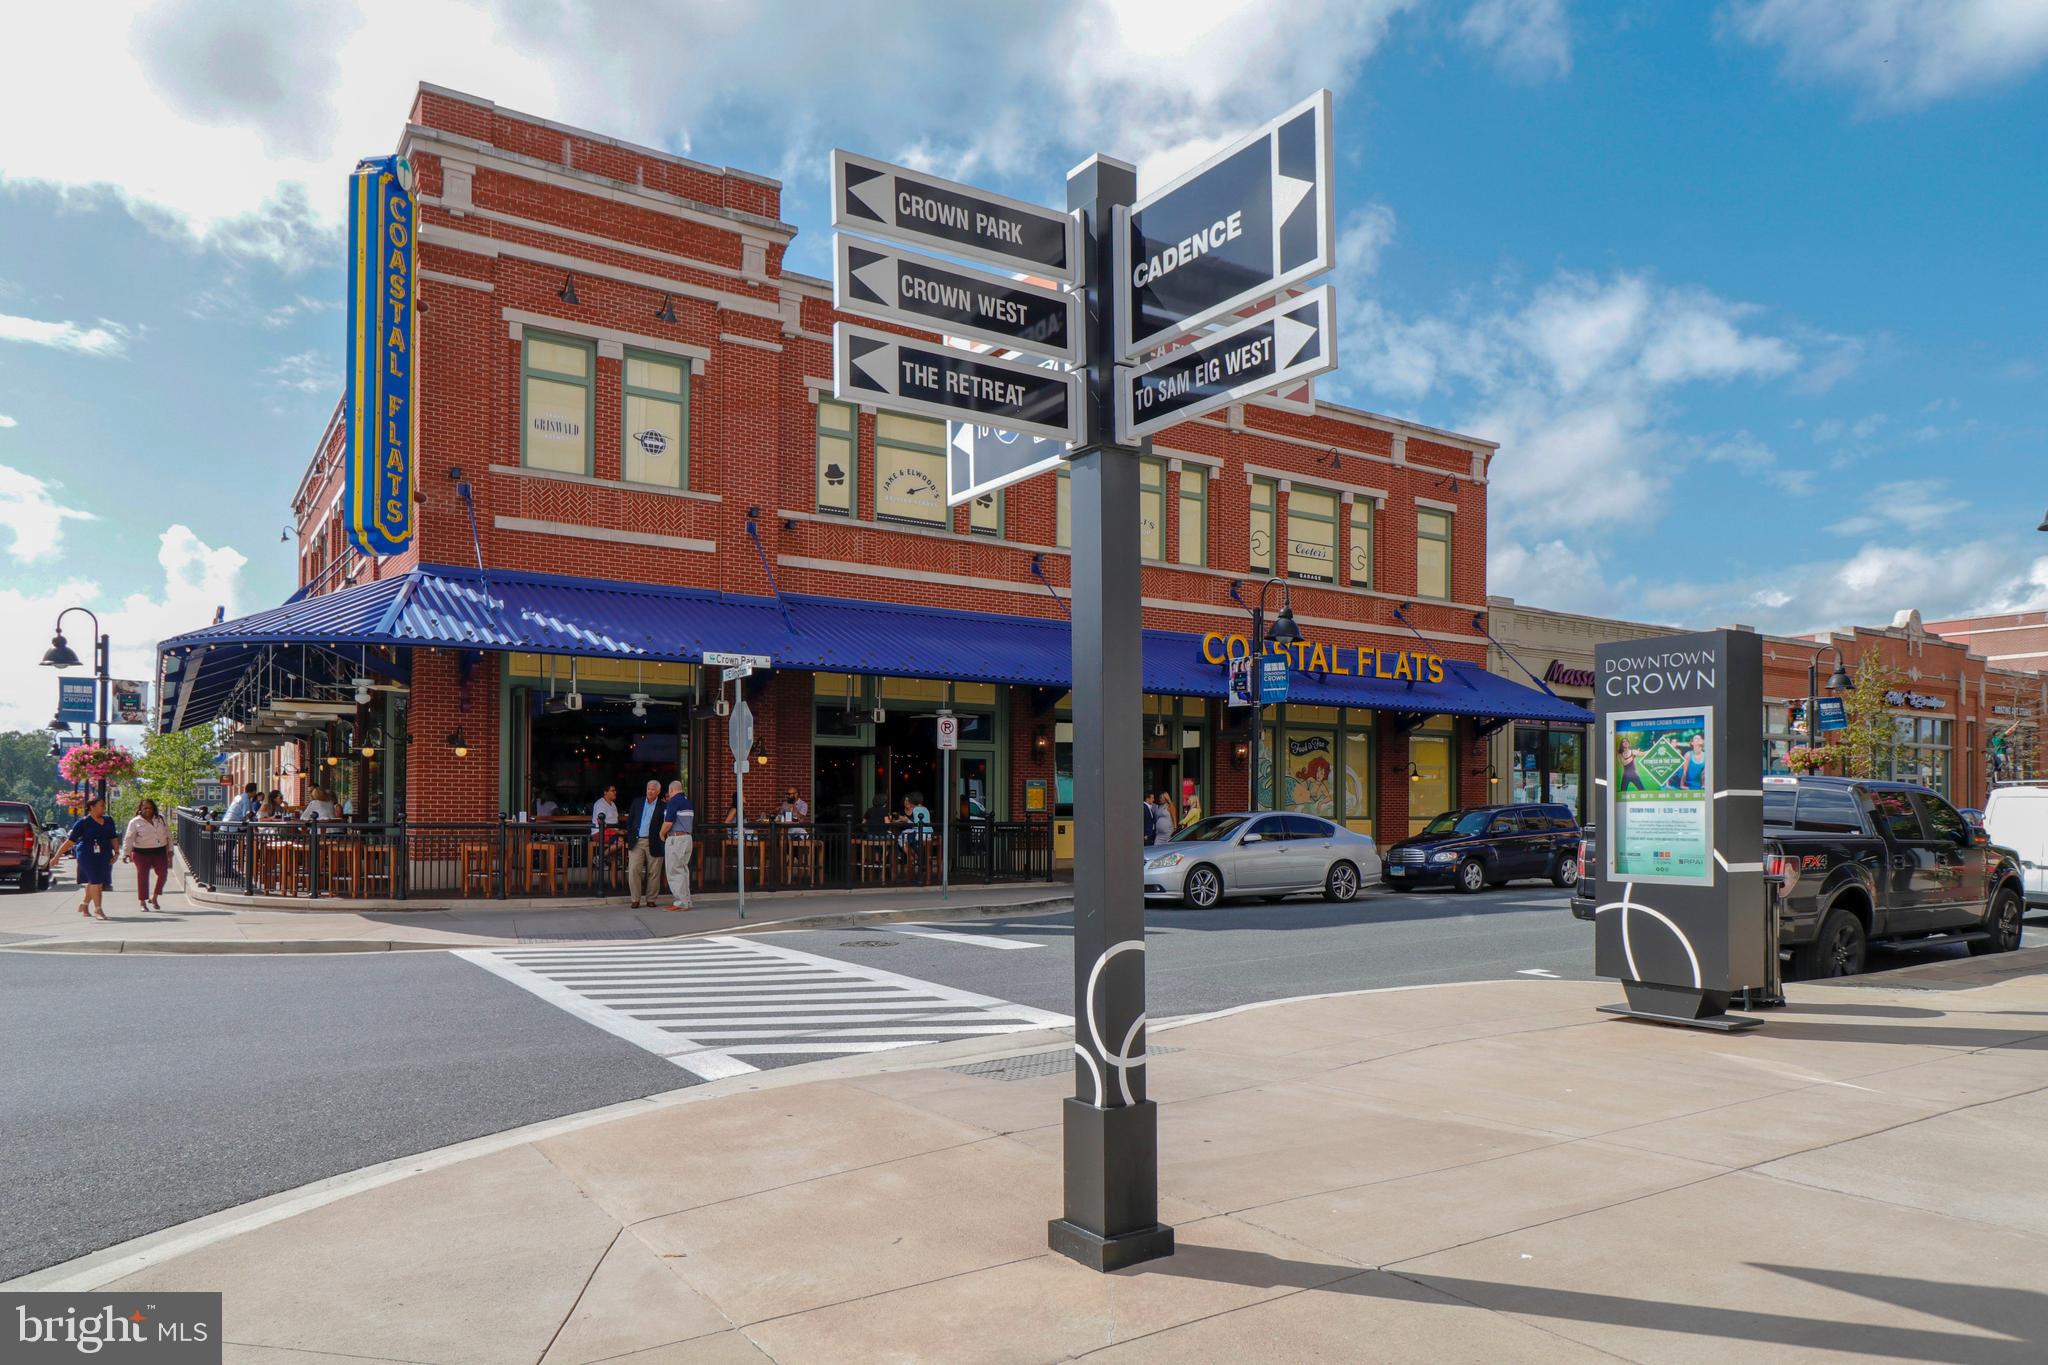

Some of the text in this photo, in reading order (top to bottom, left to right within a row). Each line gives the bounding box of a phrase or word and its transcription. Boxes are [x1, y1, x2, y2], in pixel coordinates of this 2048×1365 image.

[898, 192, 1023, 245] CROWN PARK
[1133, 210, 1242, 289] CADENCE
[901, 274, 971, 312] CROWN
[977, 293, 1028, 326] WEST
[386, 196, 407, 524] COASTAL FLATS
[1135, 336, 1272, 411] TO SAM EIG WEST
[902, 361, 1026, 407] THE RETREAT
[883, 473, 898, 491] JAKE
[899, 469, 905, 477] &
[1295, 544, 1326, 558] Cooter's
[1299, 573, 1322, 581] GARAGE
[716, 654, 739, 666] Crown
[740, 655, 758, 666] Park
[1357, 645, 1444, 684] FLATS
[1605, 650, 1715, 673] DOWNTOWN
[1605, 668, 1715, 697] CROWN
[1291, 742, 1308, 754] Food
[1802, 855, 1828, 868] FX4
